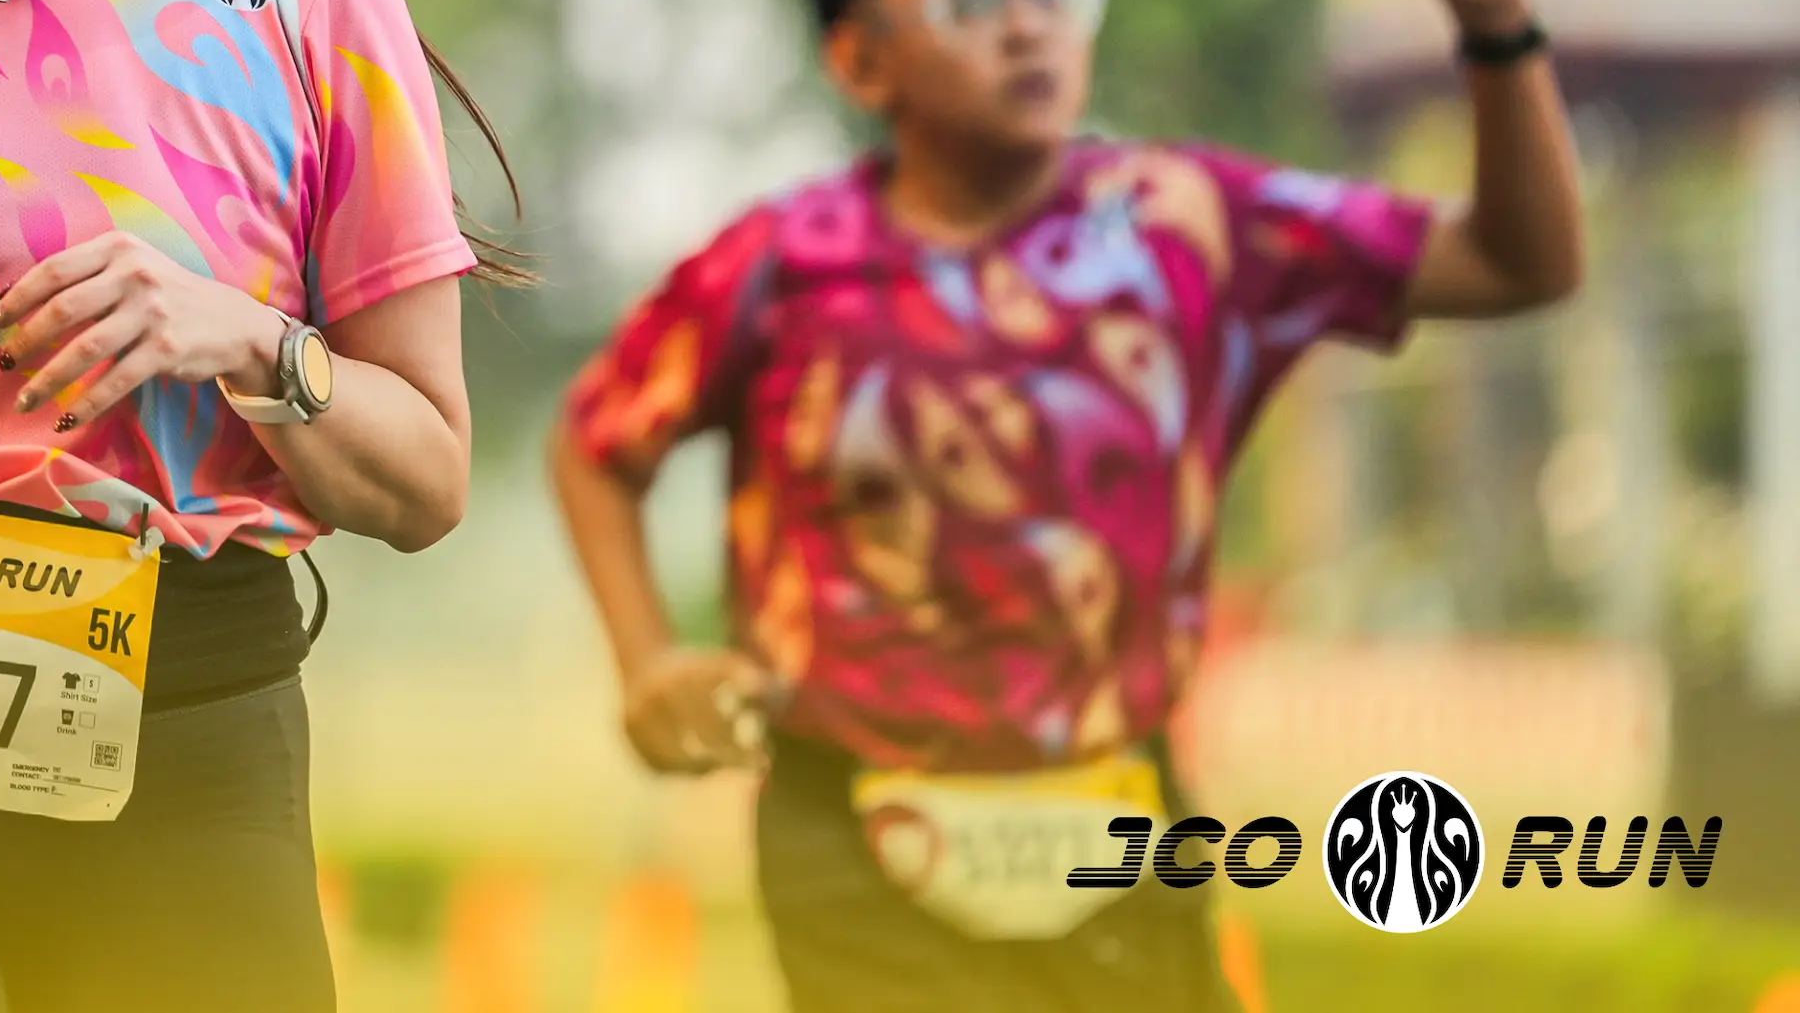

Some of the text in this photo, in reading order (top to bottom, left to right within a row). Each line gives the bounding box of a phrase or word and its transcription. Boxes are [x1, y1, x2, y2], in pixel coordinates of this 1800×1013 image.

[87, 608, 136, 657] 5K
[88, 679, 94, 688] S
[60, 691, 97, 703] Shirt Size
[57, 726, 77, 735] Drink
